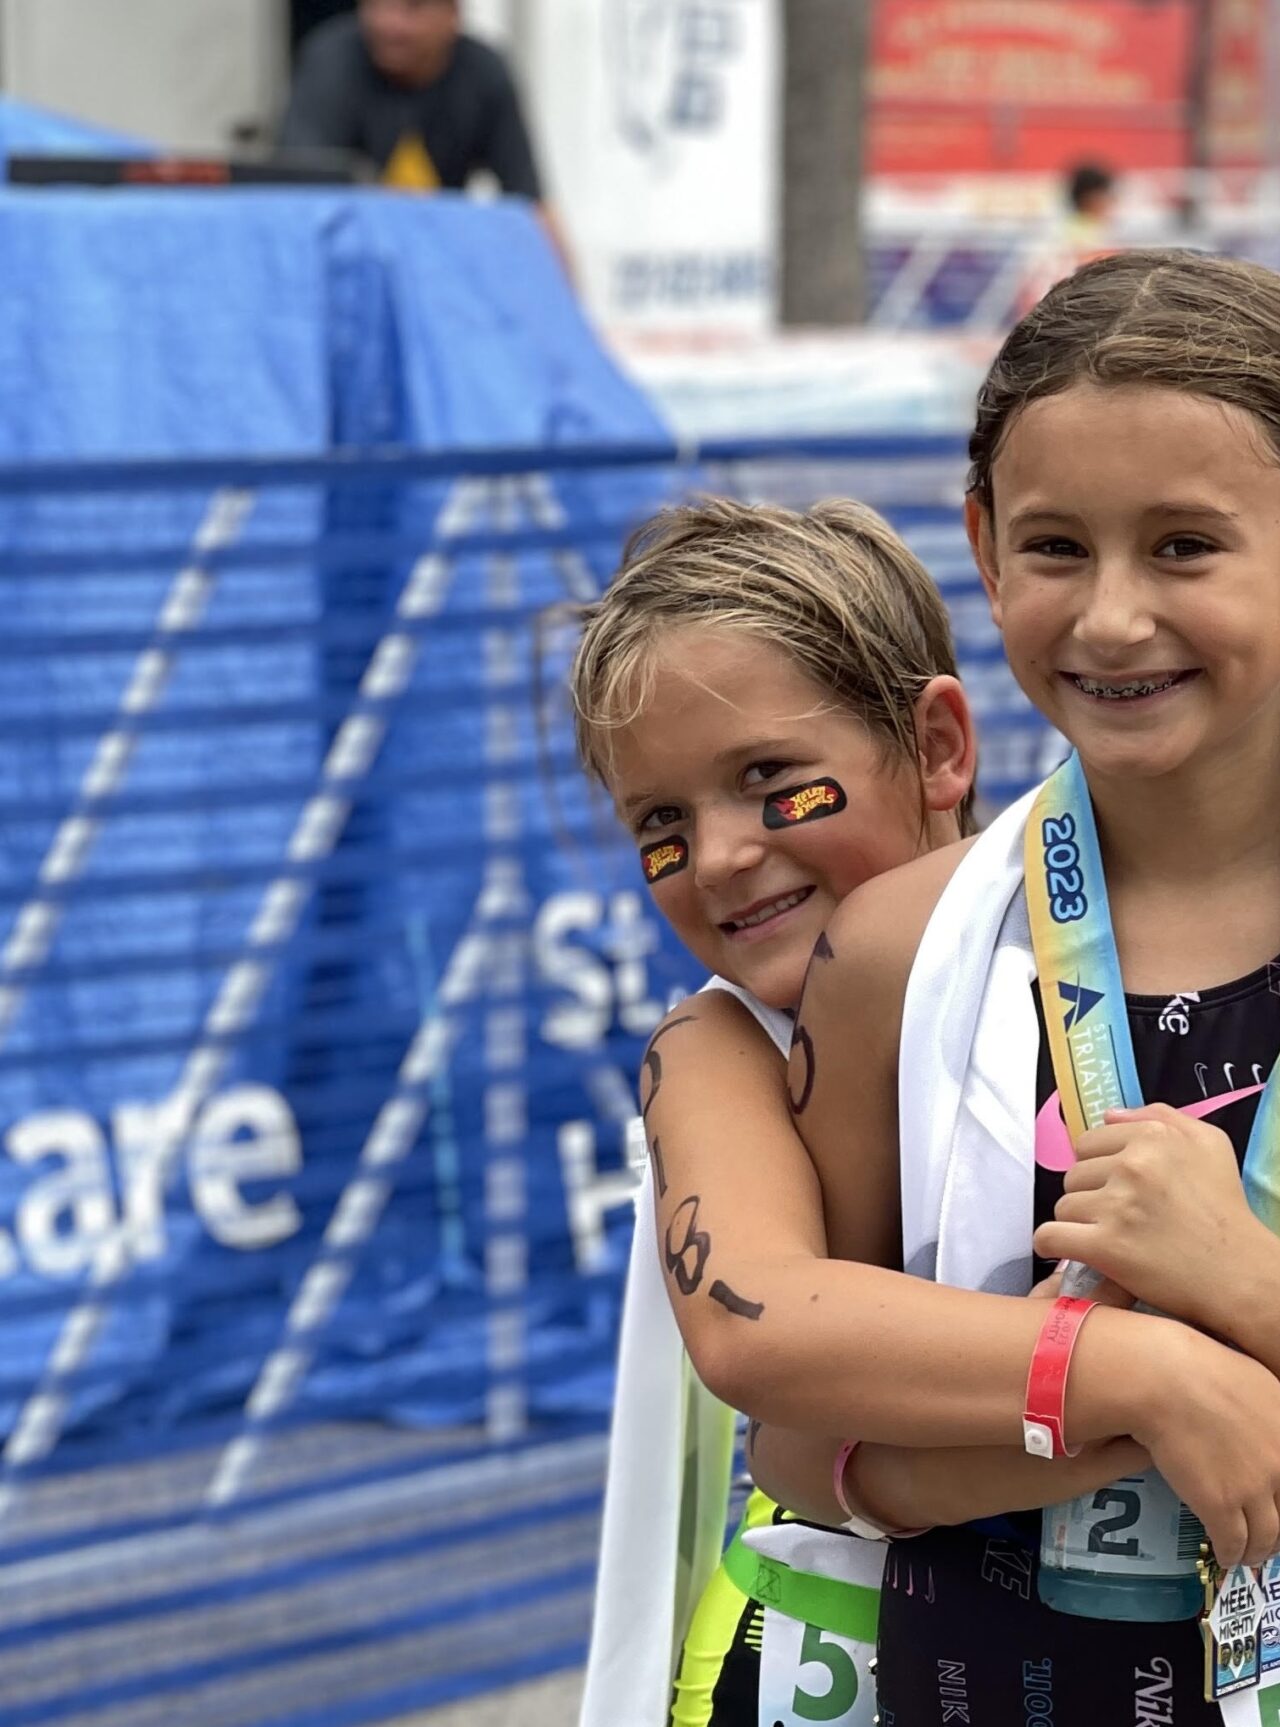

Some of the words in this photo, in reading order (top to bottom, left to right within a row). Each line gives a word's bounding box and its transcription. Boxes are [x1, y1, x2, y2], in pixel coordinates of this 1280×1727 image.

[1042, 813, 1088, 923] 2023
[0, 1082, 303, 1279] are
[1219, 1614, 1256, 1642] MIGHTY
[1220, 1583, 1257, 1617] MEEK
[937, 1659, 970, 1727] NIK
